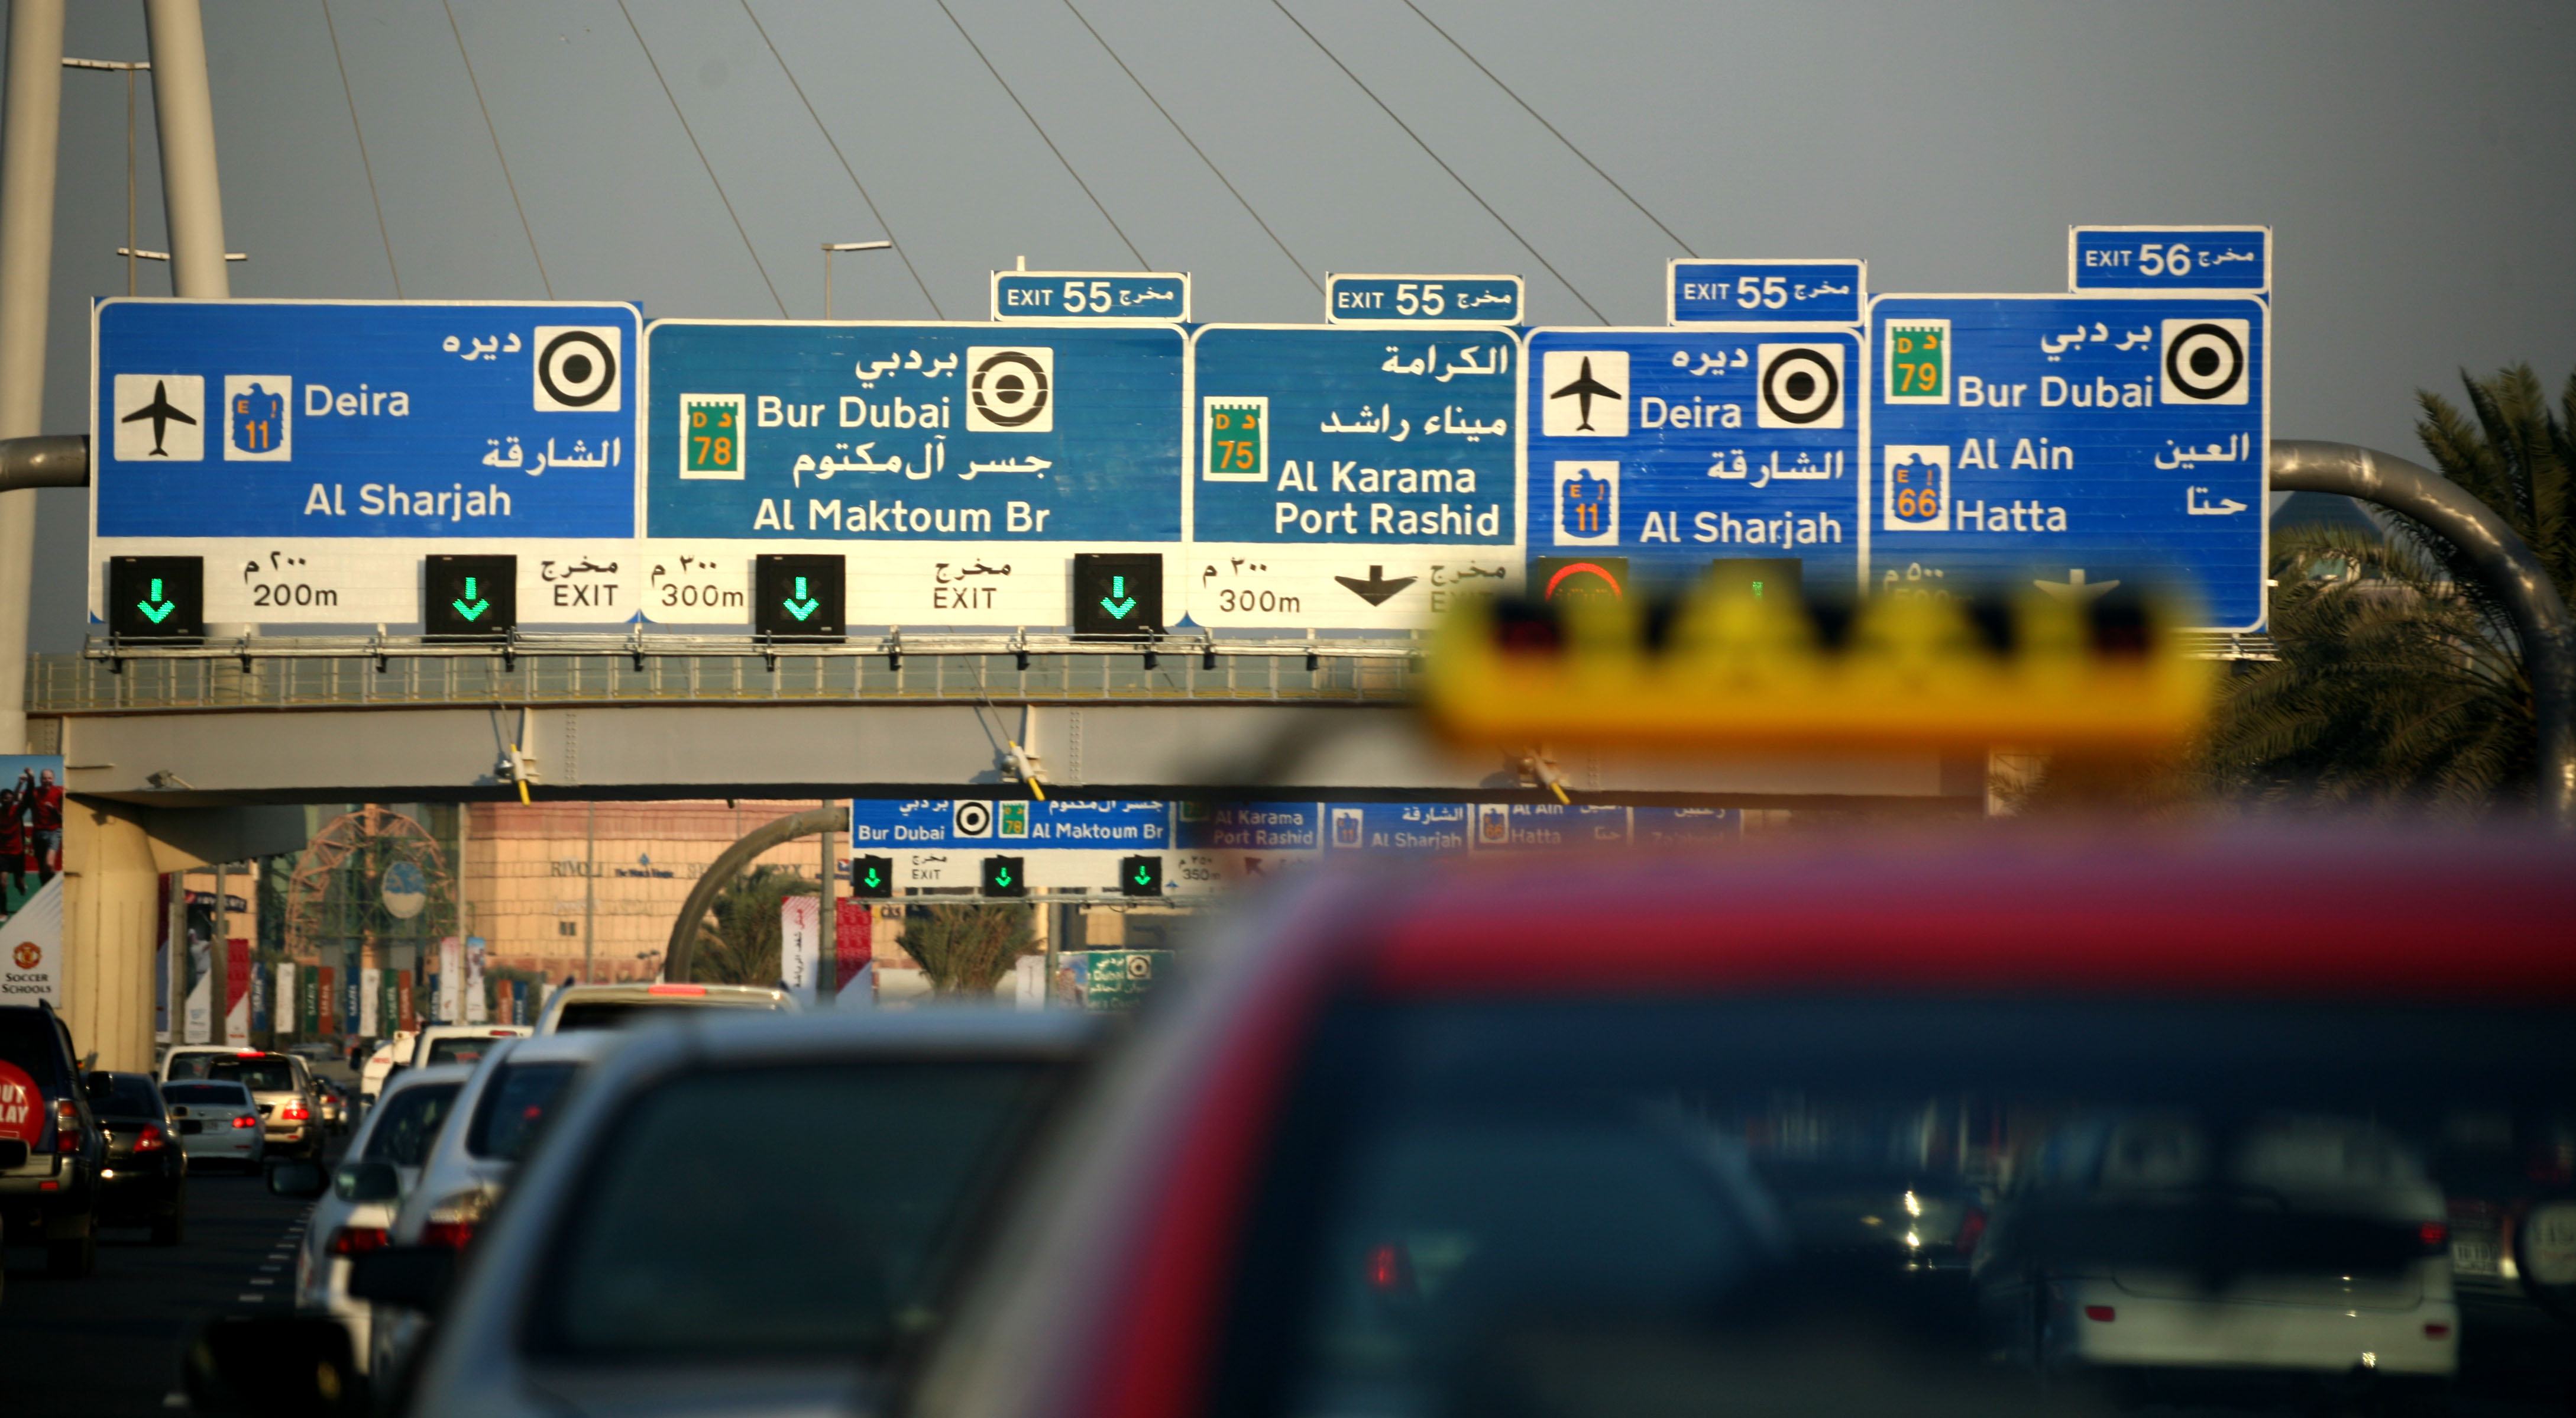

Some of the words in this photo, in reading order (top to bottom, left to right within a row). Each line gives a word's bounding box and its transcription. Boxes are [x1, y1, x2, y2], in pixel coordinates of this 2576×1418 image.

[2086, 251, 2132, 266] EXIT
[2140, 244, 2190, 276] 56
[2199, 248, 2254, 267] مخرج
[1008, 289, 1053, 305] EXIT
[1063, 282, 1112, 312] 55
[1119, 288, 1173, 306] مخرج
[1339, 292, 1384, 308] EXIT
[1397, 284, 1444, 315] 55
[1457, 290, 1512, 309] مخرج
[1684, 283, 1730, 299] EXIT
[1737, 277, 1787, 309] 55
[1795, 282, 1849, 300] مخرج
[443, 333, 521, 360] ديره
[1898, 338, 1912, 353] D
[1381, 345, 1507, 382] الكرامة
[1672, 348, 1749, 376] ديره
[1898, 363, 1937, 391] 79
[306, 384, 409, 416] Deira
[1959, 376, 2027, 407] Bur
[2041, 376, 2153, 408] Dubai
[238, 400, 249, 414] E
[693, 412, 707, 428] D
[758, 396, 825, 427] Bur
[840, 396, 949, 428] Dubai
[1641, 396, 1742, 429] Deira
[246, 421, 268, 448] 11
[1216, 414, 1230, 429] D
[1321, 404, 1410, 441] راشد
[1424, 406, 1507, 442] ميناء
[483, 437, 620, 476] الشارقة
[694, 437, 731, 465] 78
[1218, 441, 1254, 469] 75
[1959, 438, 1998, 469] Al
[2011, 437, 2073, 469] Ain
[2155, 433, 2249, 469] العين
[958, 456, 1052, 480] جسر
[1277, 460, 1318, 492] Al
[1332, 461, 1475, 493] Karama
[1708, 450, 1843, 488] الشارقة
[1898, 470, 1908, 483] E
[305, 483, 345, 515] Al
[360, 483, 511, 522] Sharjah
[1571, 484, 1581, 498] E
[1899, 489, 1936, 516] 66
[2187, 486, 2247, 515] حتا
[753, 499, 794, 530] Al
[810, 499, 991, 532] Maktoum
[1007, 501, 1050, 532] Br
[1276, 502, 1357, 534] Port
[1371, 503, 1499, 536] Rashid
[1576, 503, 1598, 531] 11
[1957, 500, 2066, 531] Hatta
[1640, 512, 1681, 542] Al
[1694, 511, 1841, 549] Sharjah
[244, 561, 262, 587] م
[542, 555, 618, 582] مخرج
[652, 565, 668, 590] م
[936, 560, 1011, 583] مخرج
[1203, 566, 1217, 589] م
[1431, 560, 1506, 587] مخرج
[254, 584, 336, 606] 200m
[555, 584, 618, 606] EXIT
[662, 584, 743, 606] 300m
[934, 587, 996, 608] EXIT
[1221, 589, 1299, 612] 300m
[1005, 821, 1023, 834] 78
[1215, 810, 1232, 825] Al
[1239, 810, 1303, 826] Karama
[1402, 806, 1464, 825] الشارقة
[859, 825, 889, 840] Bur
[894, 825, 944, 840] Dubai
[1033, 823, 1050, 838] Al
[1056, 823, 1137, 839] Maktoum
[1143, 824, 1163, 839] Br
[1215, 830, 1250, 844] Port
[1255, 829, 1313, 845] Rashid
[1371, 832, 1388, 847] Al
[1395, 831, 1462, 850] Sharjah
[1511, 829, 1562, 844] Hatta
[912, 870, 941, 880] EXIT
[1183, 868, 1221, 880] 350m
[2, 984, 51, 994] SCHOOLS
[5, 973, 48, 982] SOCCER
